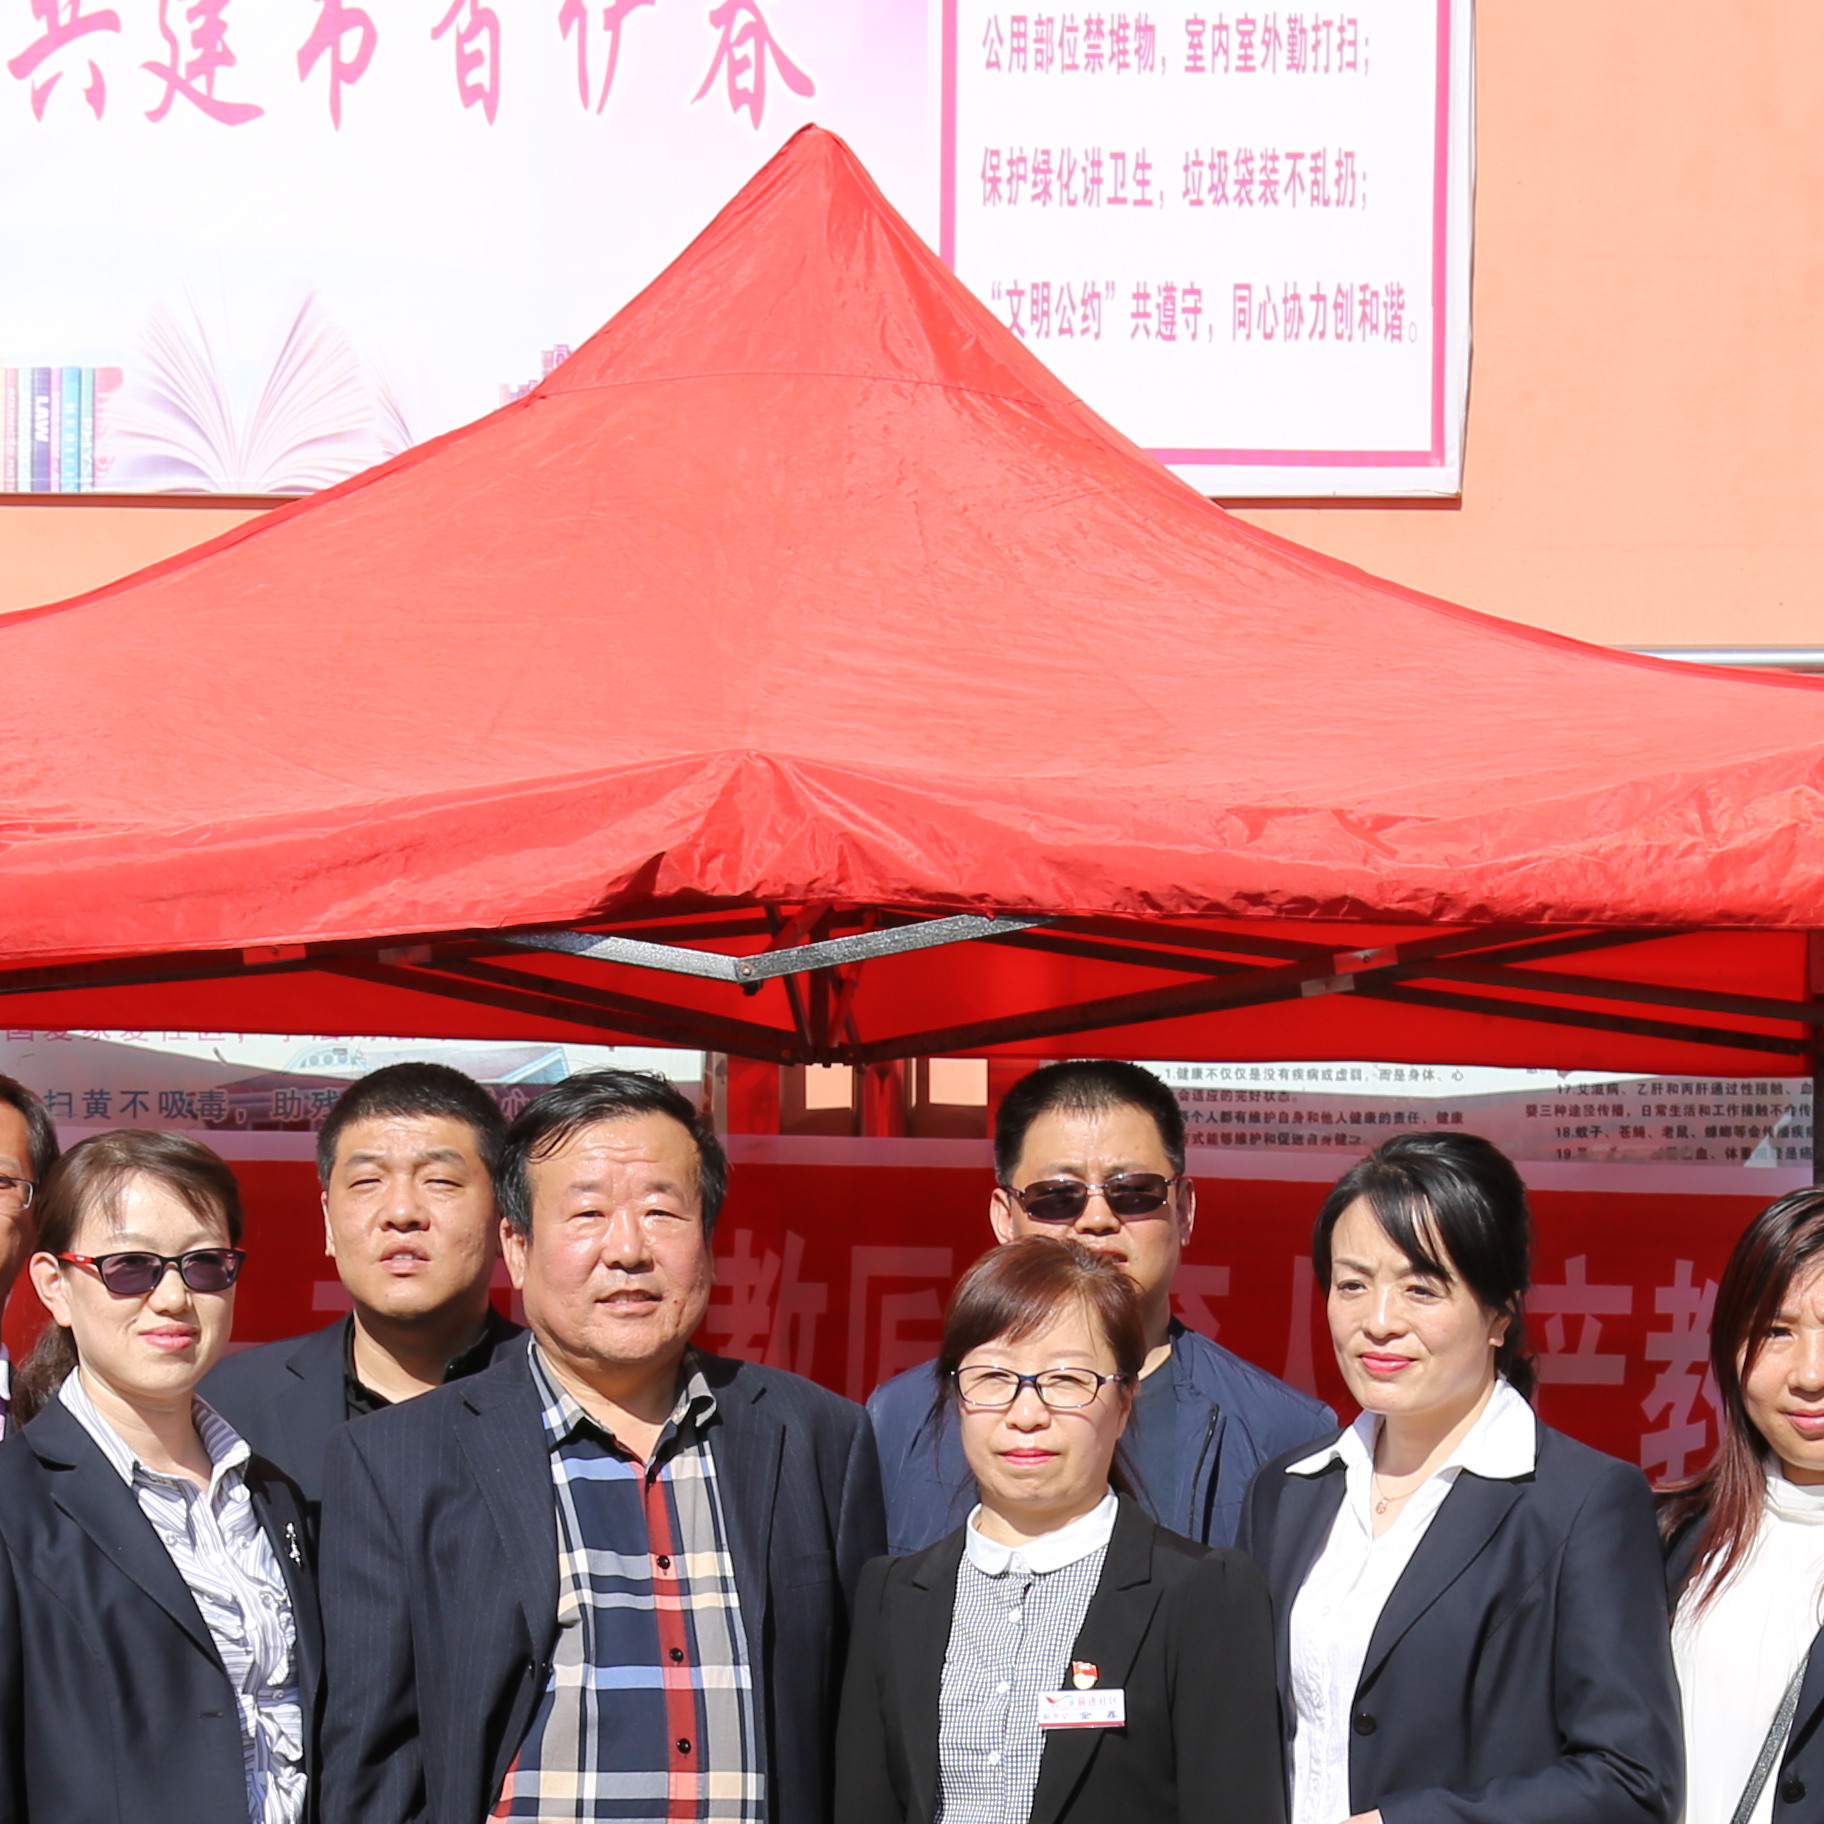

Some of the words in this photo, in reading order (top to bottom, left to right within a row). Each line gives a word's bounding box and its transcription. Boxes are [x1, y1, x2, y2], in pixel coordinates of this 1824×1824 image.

[982, 12, 1370, 76] 公用部位禁堆物，室内室外勤打扫；
[981, 146, 1368, 210] 保护绿化讲卫生，垃圾袋装不乱扔；
[35, 396, 49, 442] LAW
